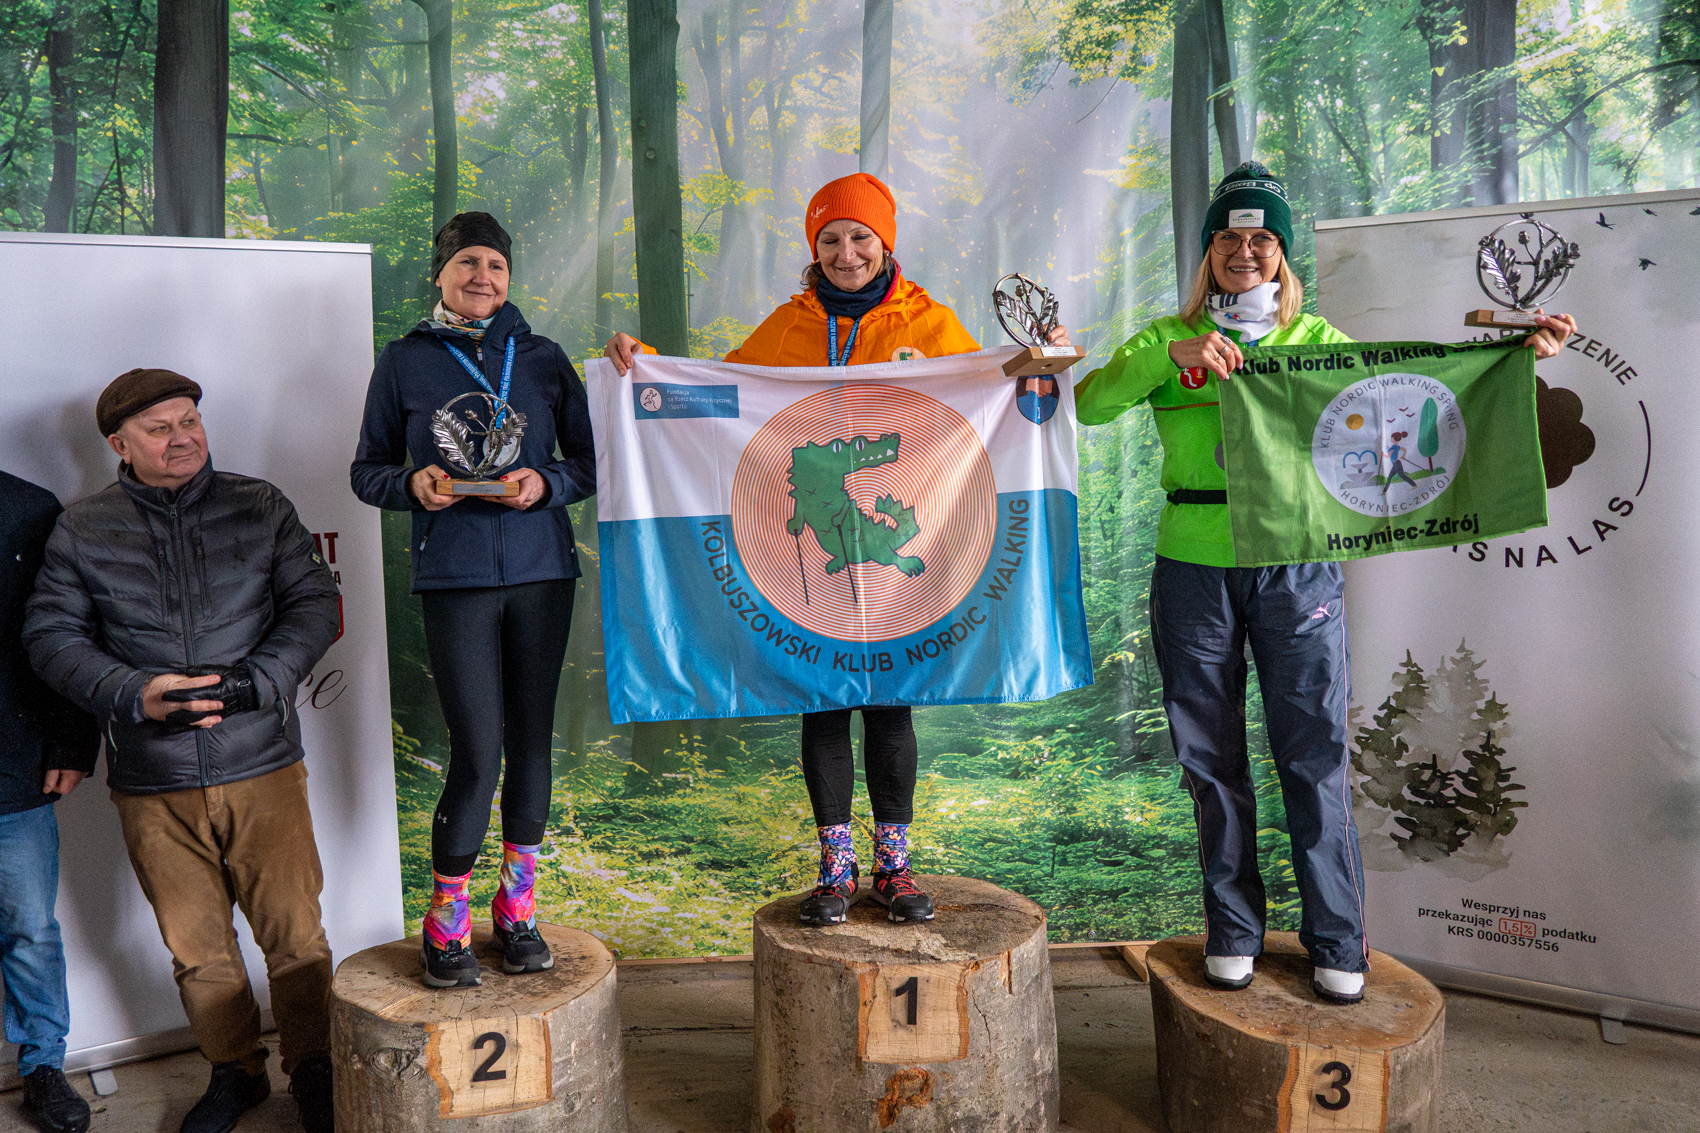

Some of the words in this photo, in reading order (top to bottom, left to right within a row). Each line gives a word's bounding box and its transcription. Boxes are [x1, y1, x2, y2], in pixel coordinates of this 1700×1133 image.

[1236, 357, 1280, 376] Klub
[1287, 352, 1356, 372] Nordic
[1360, 346, 1447, 368] Walking
[1320, 418, 1336, 449] KLUB
[1332, 381, 1376, 416] NORDIC
[1378, 377, 1438, 395] WALKING
[1437, 392, 1459, 430] SPING
[1340, 475, 1450, 513] HORYNIEC-ZDRÓJ
[1326, 513, 1479, 551] Horyniec-Zdrój
[700, 521, 822, 665] KOLBUSZOWSKI
[832, 651, 894, 673] KLUB
[904, 606, 988, 666] NORDIC
[982, 498, 1030, 602] WALKING
[1418, 907, 1493, 928] przekazując
[1542, 927, 1597, 944] podatku
[1461, 898, 1520, 918] Wesprzyj
[1523, 910, 1547, 920] nas
[1448, 925, 1474, 938] KRS
[1477, 930, 1559, 952] 0000357556
[895, 976, 918, 1026] 1
[470, 1032, 508, 1082] 2
[1316, 1061, 1352, 1110] 3
